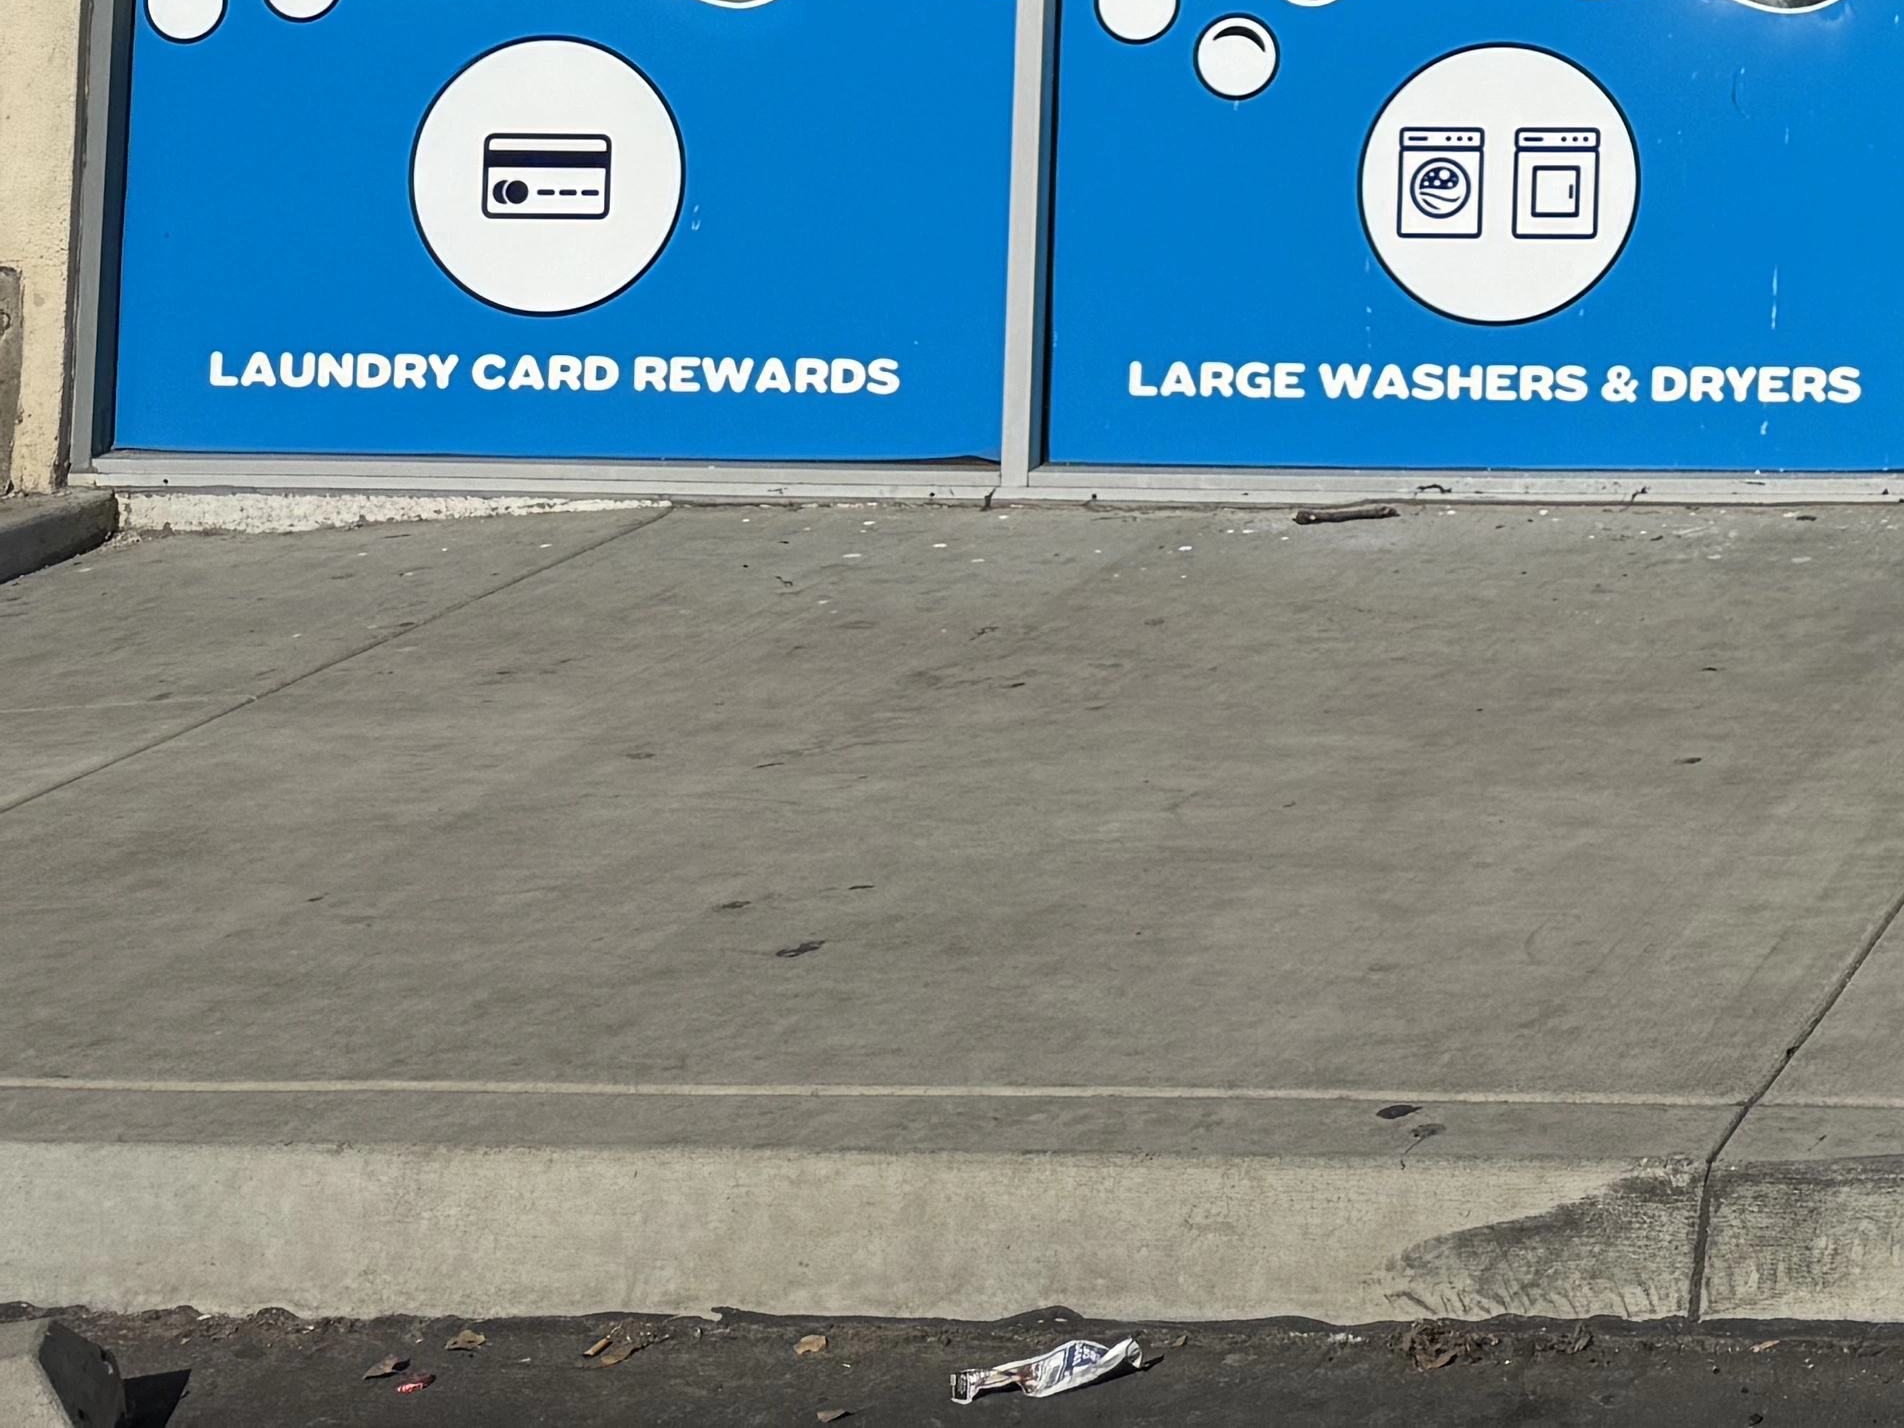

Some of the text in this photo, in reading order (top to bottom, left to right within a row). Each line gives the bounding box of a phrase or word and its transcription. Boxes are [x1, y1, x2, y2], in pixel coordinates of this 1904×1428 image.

[210, 351, 900, 395] LAUNDRY CARD REWARDS
[1128, 360, 1862, 404] LARGE WASHERS & DRYERS
